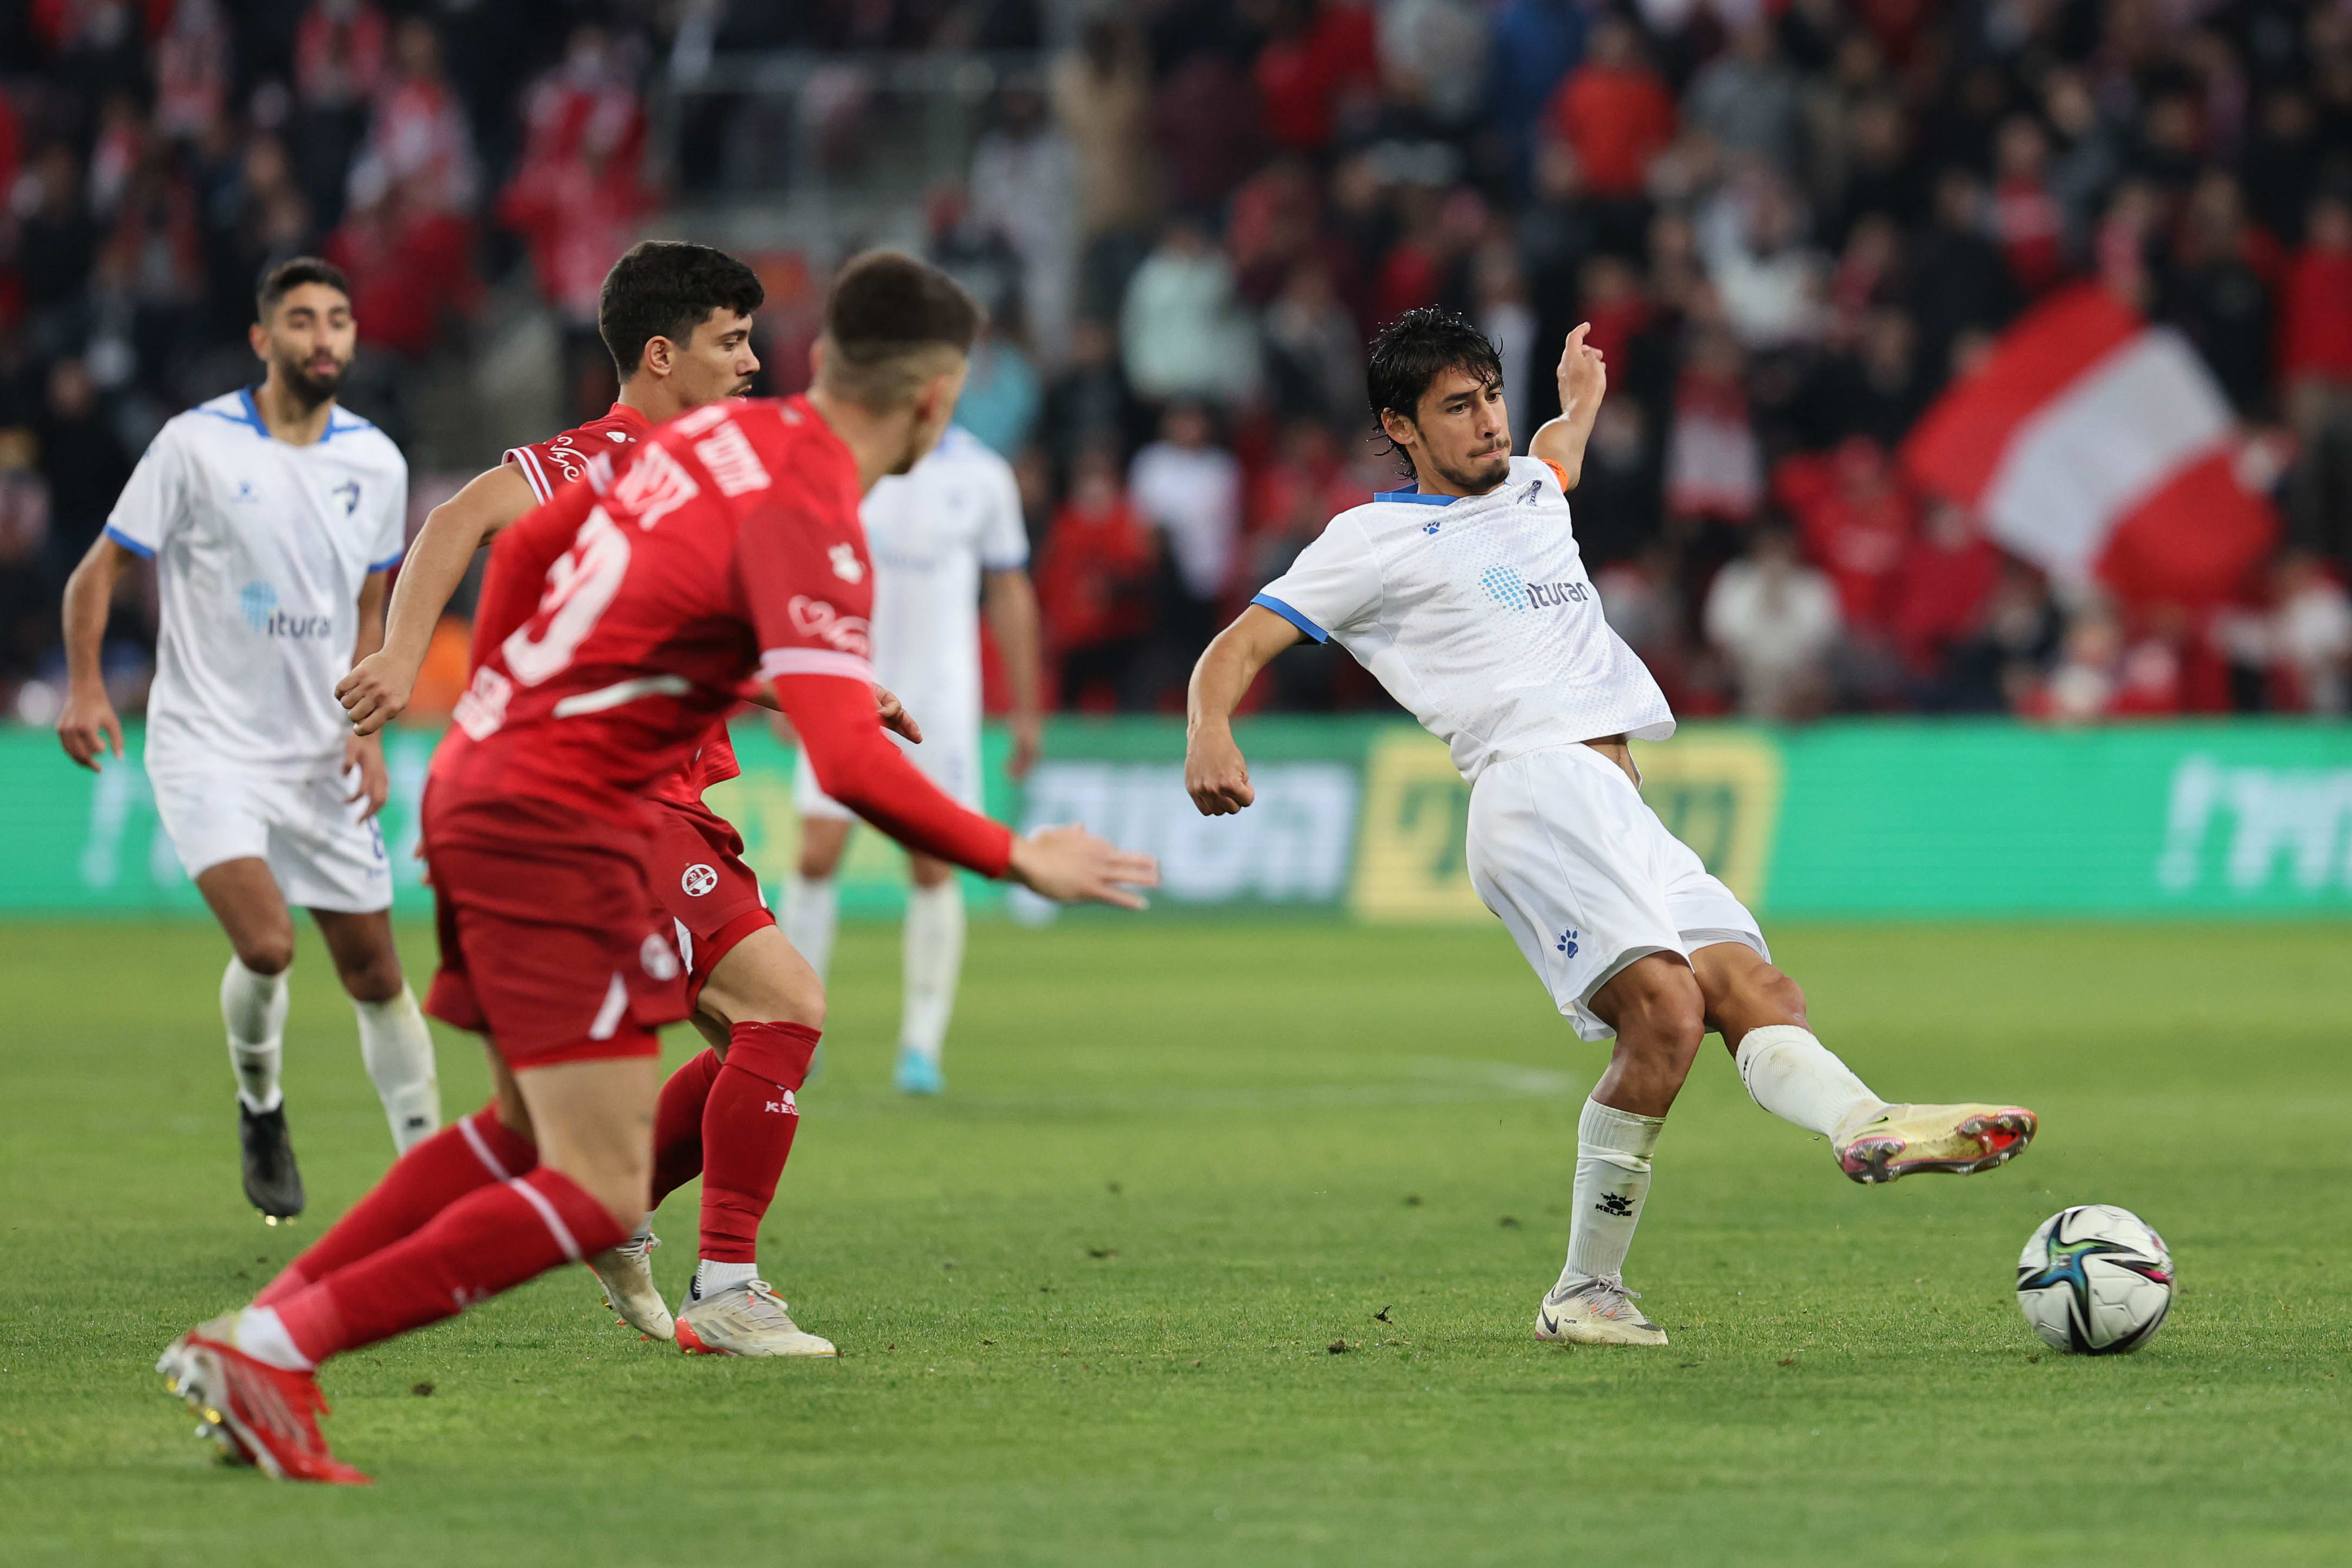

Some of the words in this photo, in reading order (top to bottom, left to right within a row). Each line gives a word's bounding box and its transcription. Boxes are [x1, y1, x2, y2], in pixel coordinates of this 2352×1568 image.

[1525, 582, 1589, 609] ituran
[268, 610, 332, 639] itura
[764, 1100, 800, 1116] KEL
[1595, 1203, 1633, 1217] KELME
